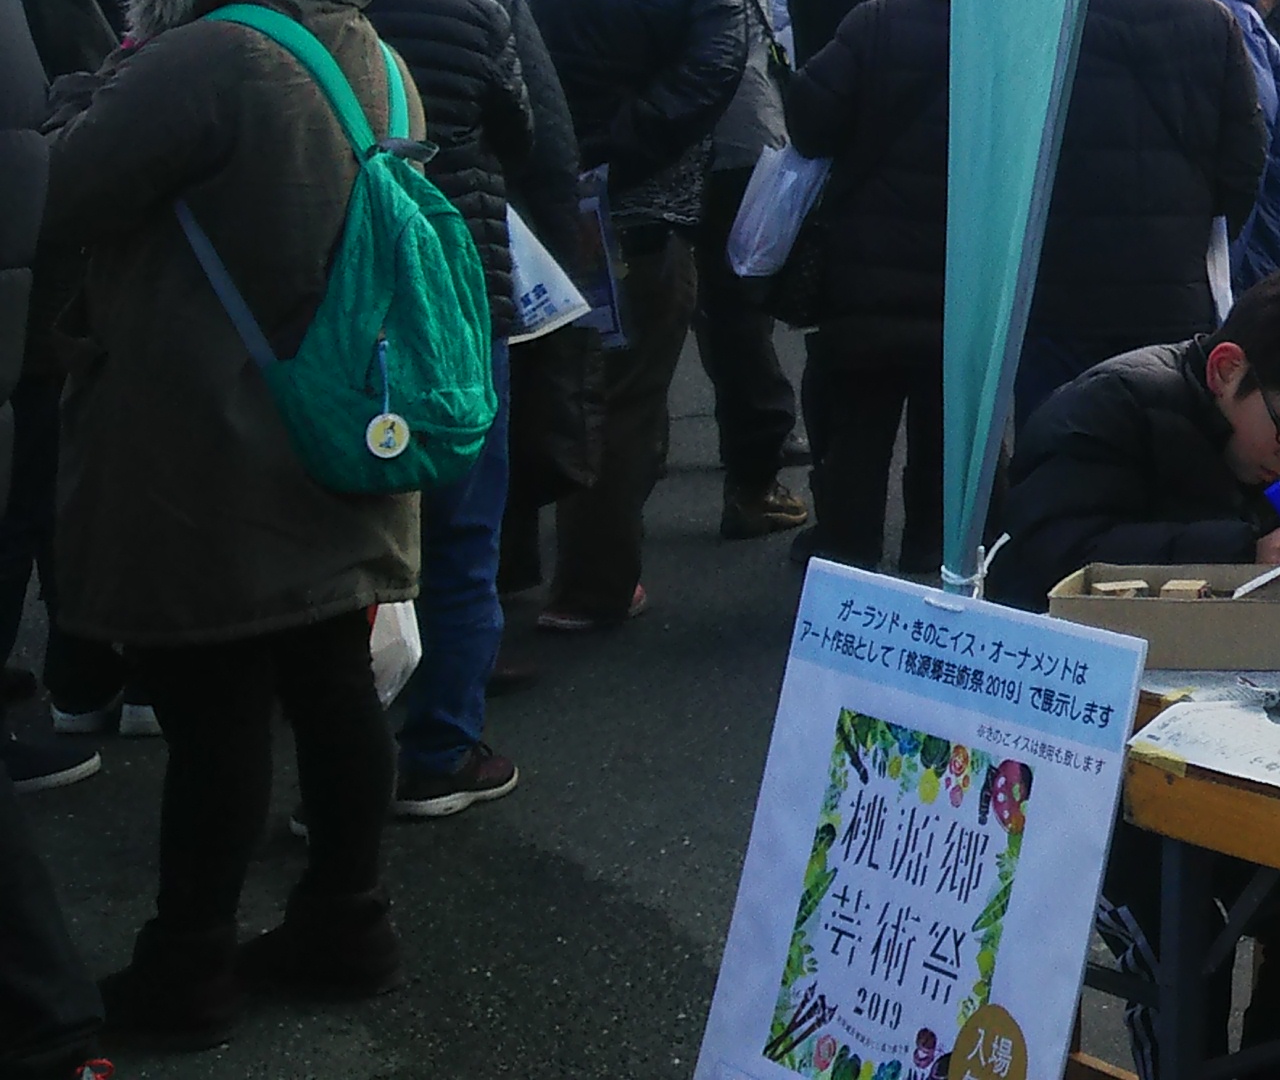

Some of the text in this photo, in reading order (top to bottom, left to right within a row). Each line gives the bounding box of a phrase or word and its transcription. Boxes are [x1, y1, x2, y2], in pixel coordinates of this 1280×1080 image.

[840, 789, 989, 905] 桃源郷
[824, 885, 966, 1005] 芸術祭
[853, 987, 903, 1030] 2019
[967, 1028, 1013, 1078] 入場
